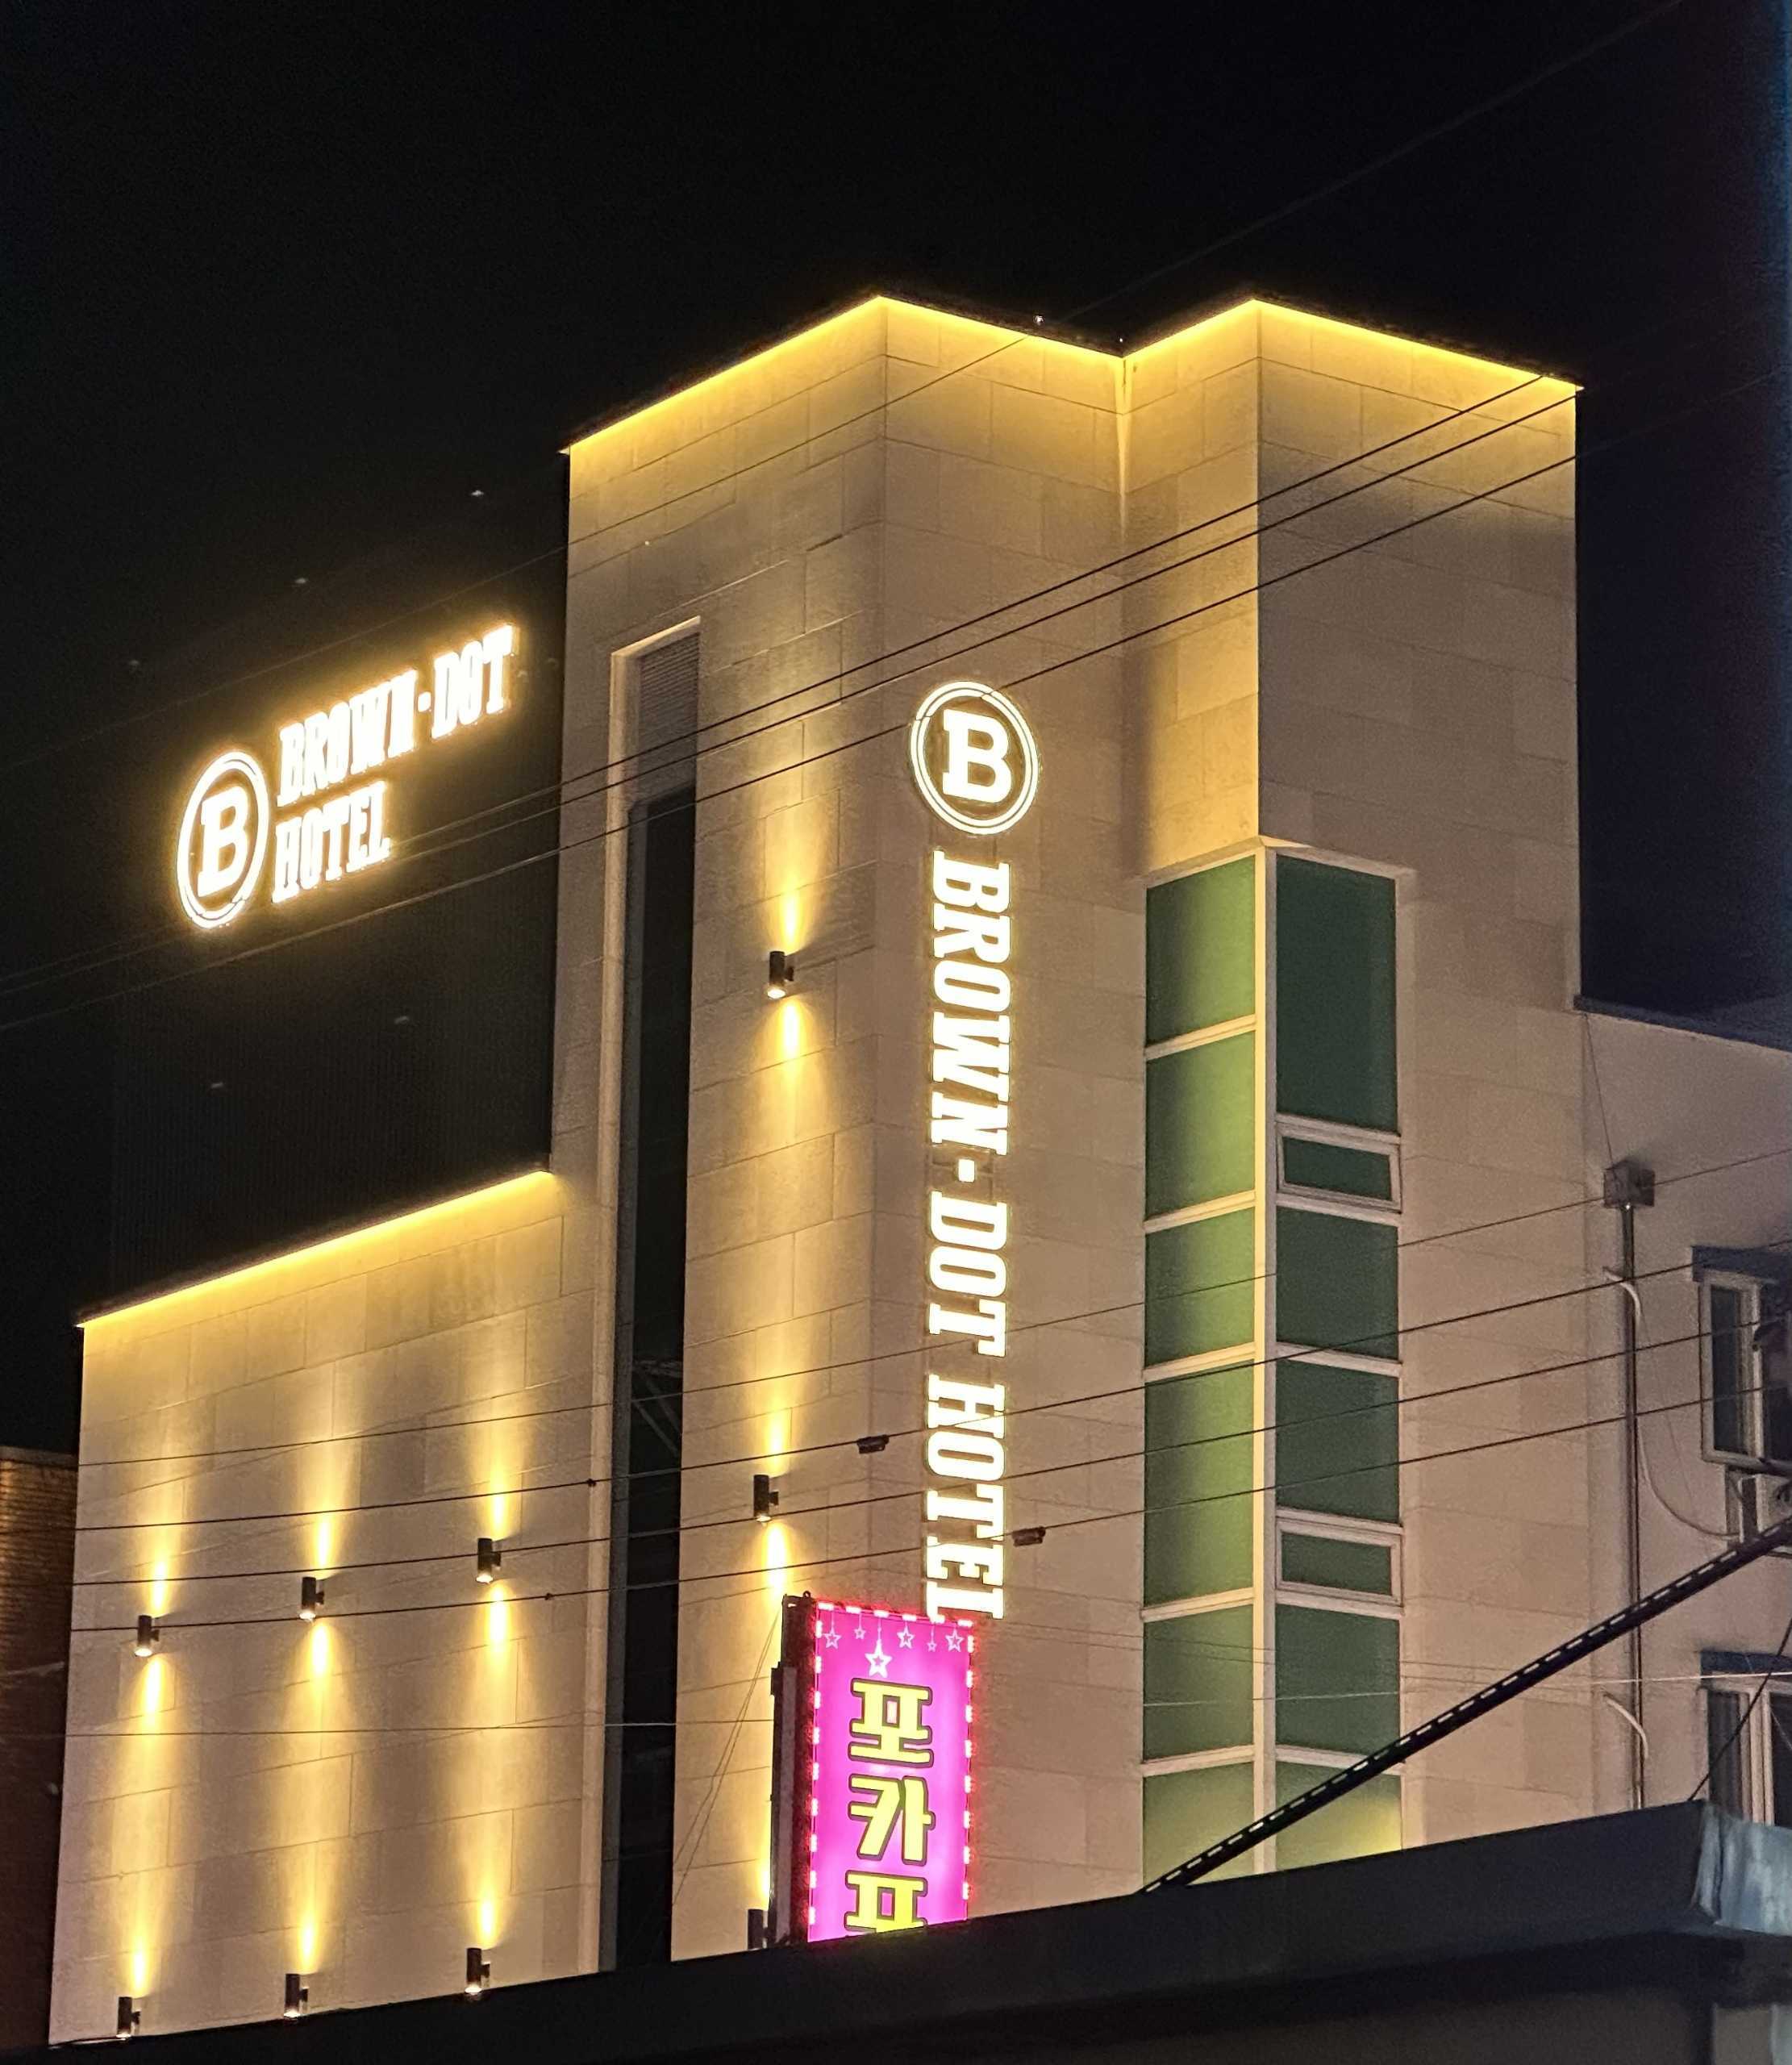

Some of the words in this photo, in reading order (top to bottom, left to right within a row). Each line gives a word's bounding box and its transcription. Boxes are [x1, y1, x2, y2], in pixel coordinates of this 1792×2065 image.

[942, 709, 1012, 803] B
[198, 786, 249, 897] B
[272, 780, 391, 903] HOTEL
[926, 1375, 1004, 1623] HOTEL
